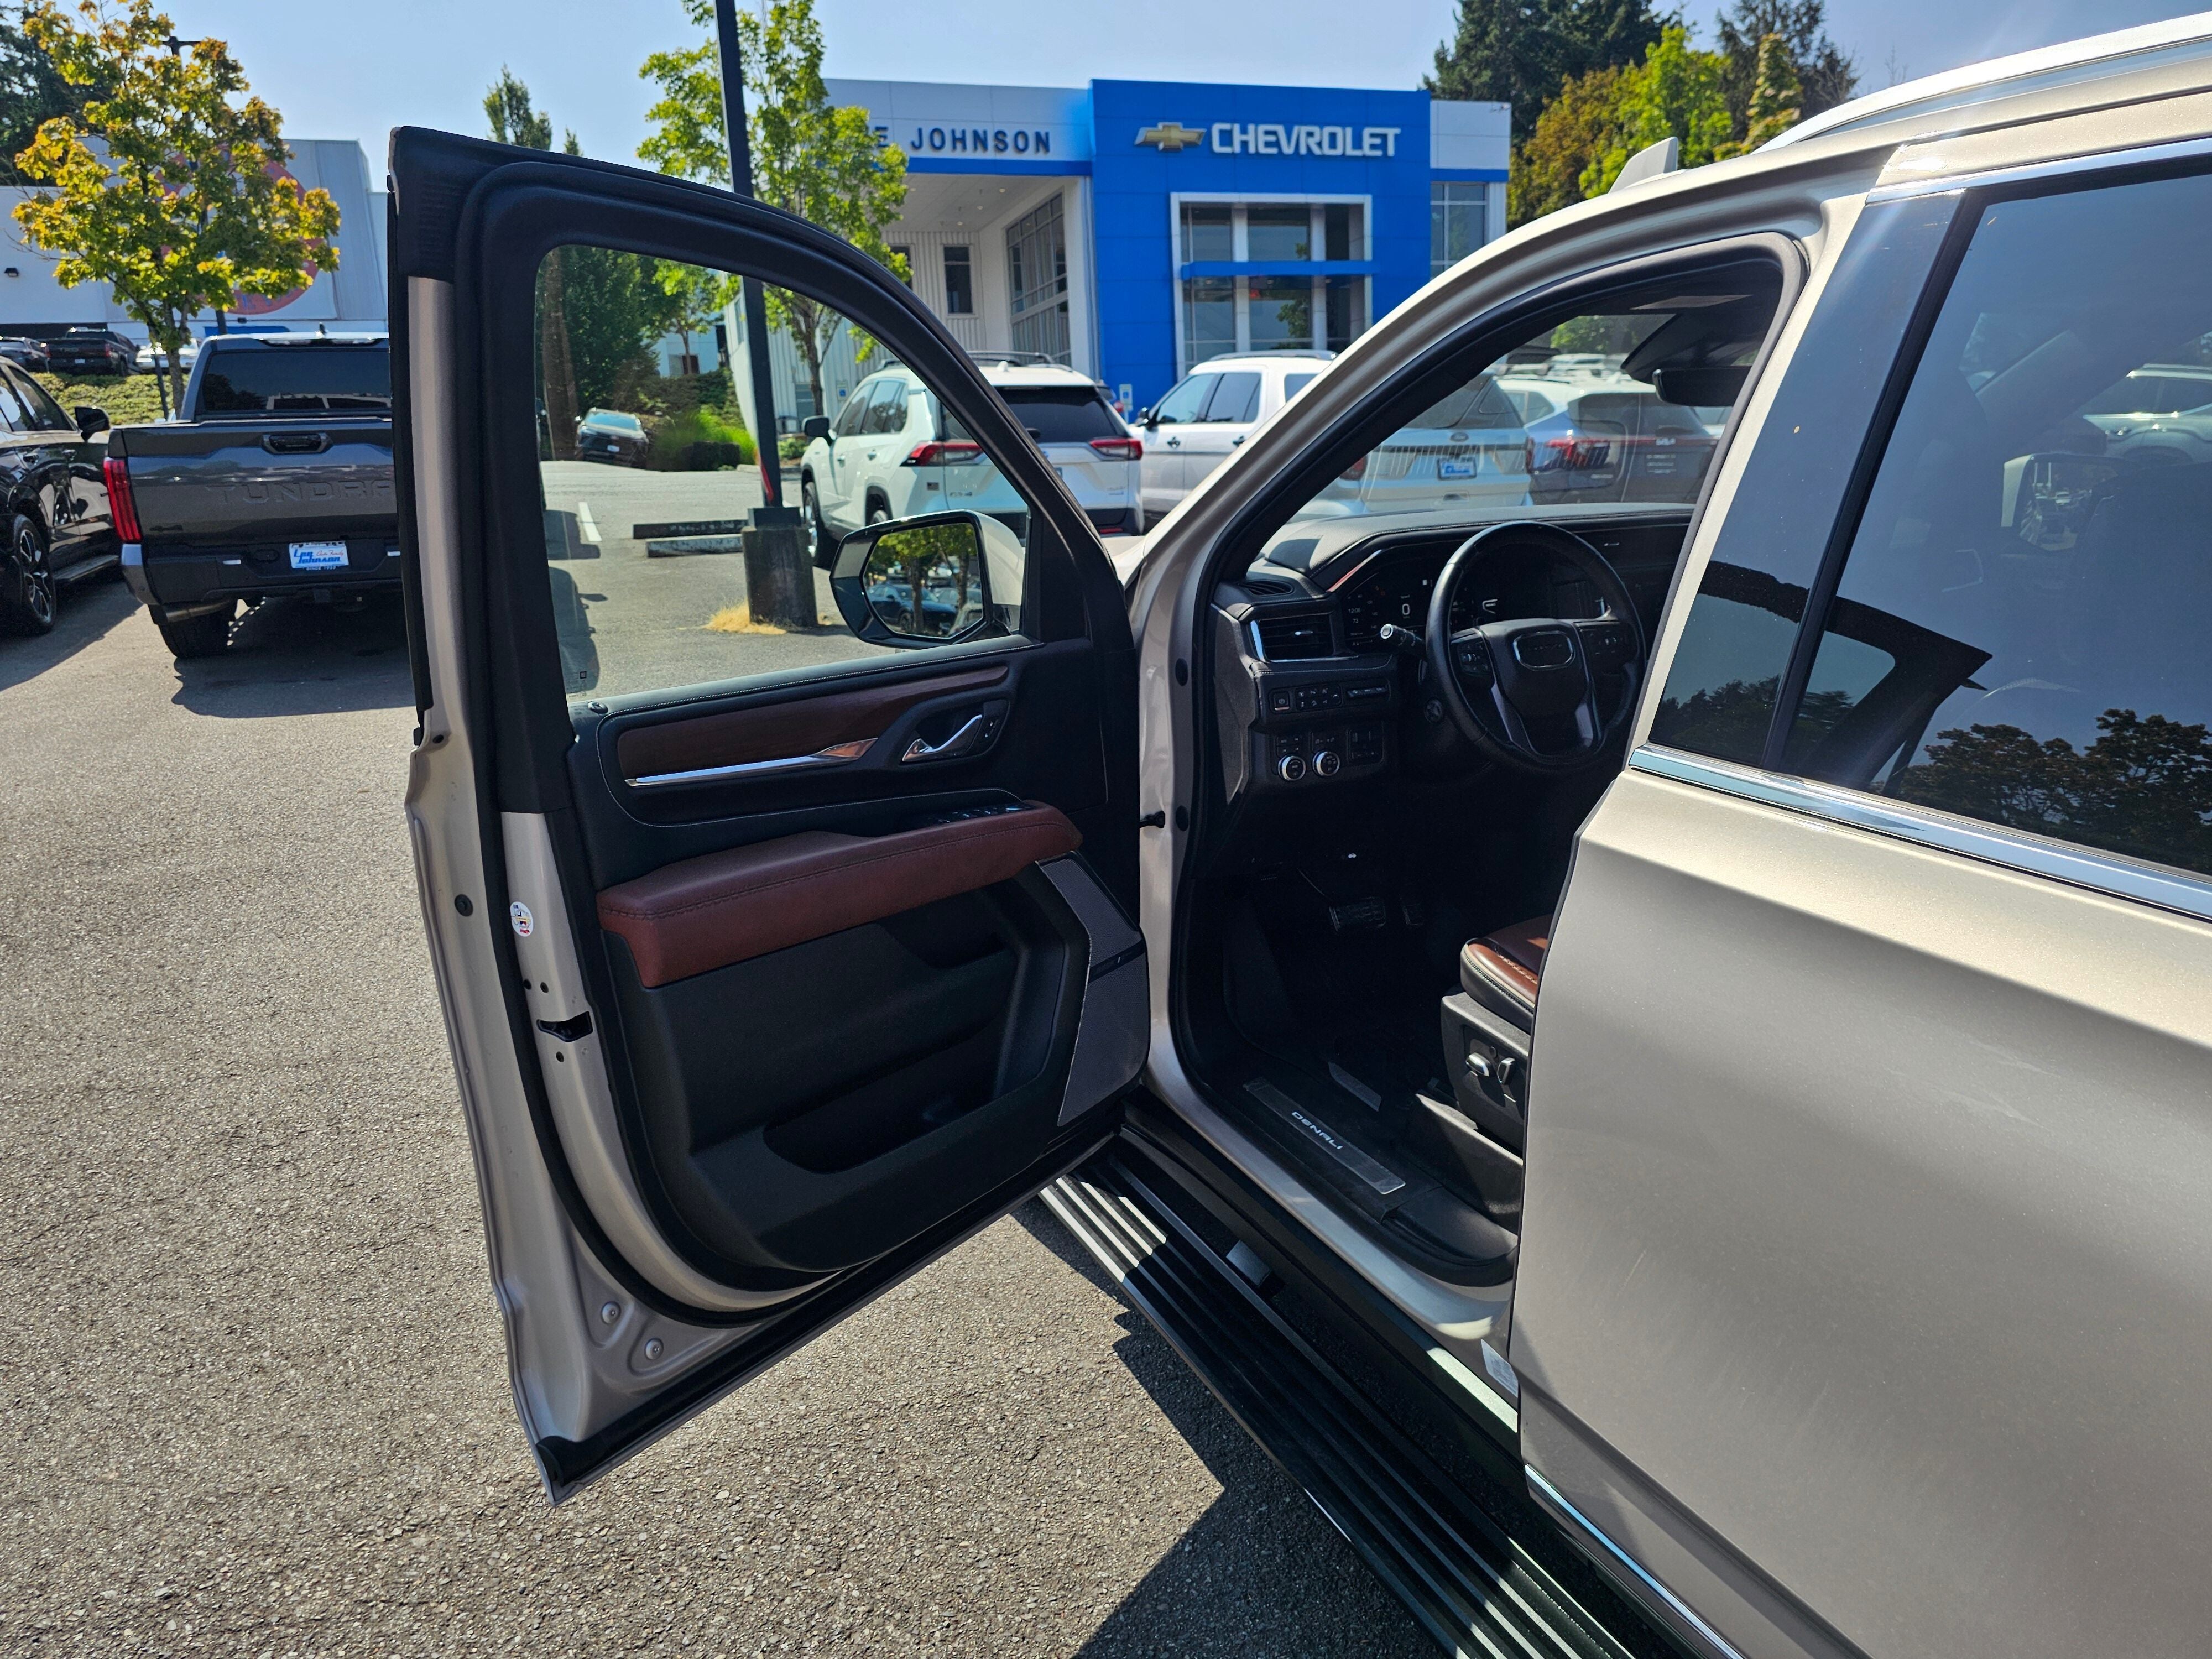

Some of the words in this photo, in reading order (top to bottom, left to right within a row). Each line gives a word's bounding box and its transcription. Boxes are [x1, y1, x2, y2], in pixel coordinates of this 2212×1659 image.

[910, 127, 1050, 153] JOHNSON
[1212, 122, 1401, 157] CHEVROLET
[205, 479, 396, 504] TUNDRA
[1292, 1112, 1343, 1149] DENALI
